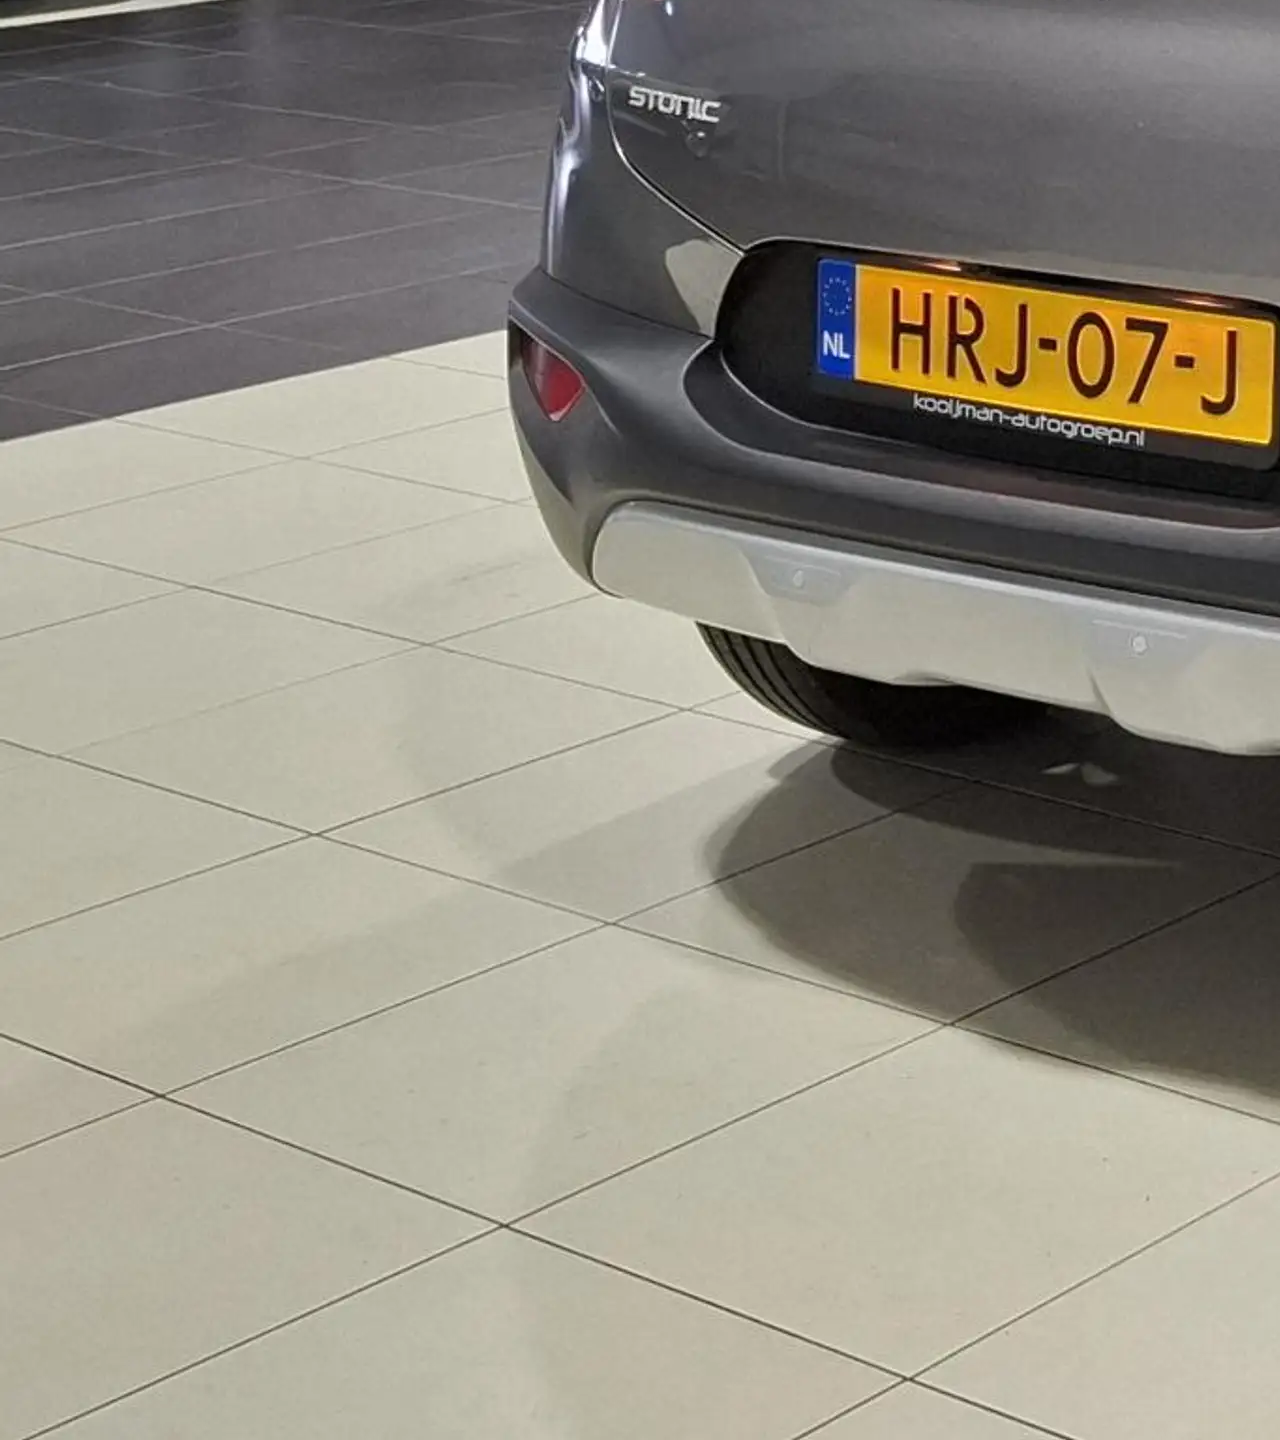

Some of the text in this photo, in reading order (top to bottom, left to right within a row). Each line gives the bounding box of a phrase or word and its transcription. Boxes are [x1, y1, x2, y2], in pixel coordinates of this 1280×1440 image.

[628, 85, 722, 123] STONIC
[822, 287, 1238, 416] NL HRJ-07-J
[912, 392, 1146, 448] kooijman-autogroep.nl
